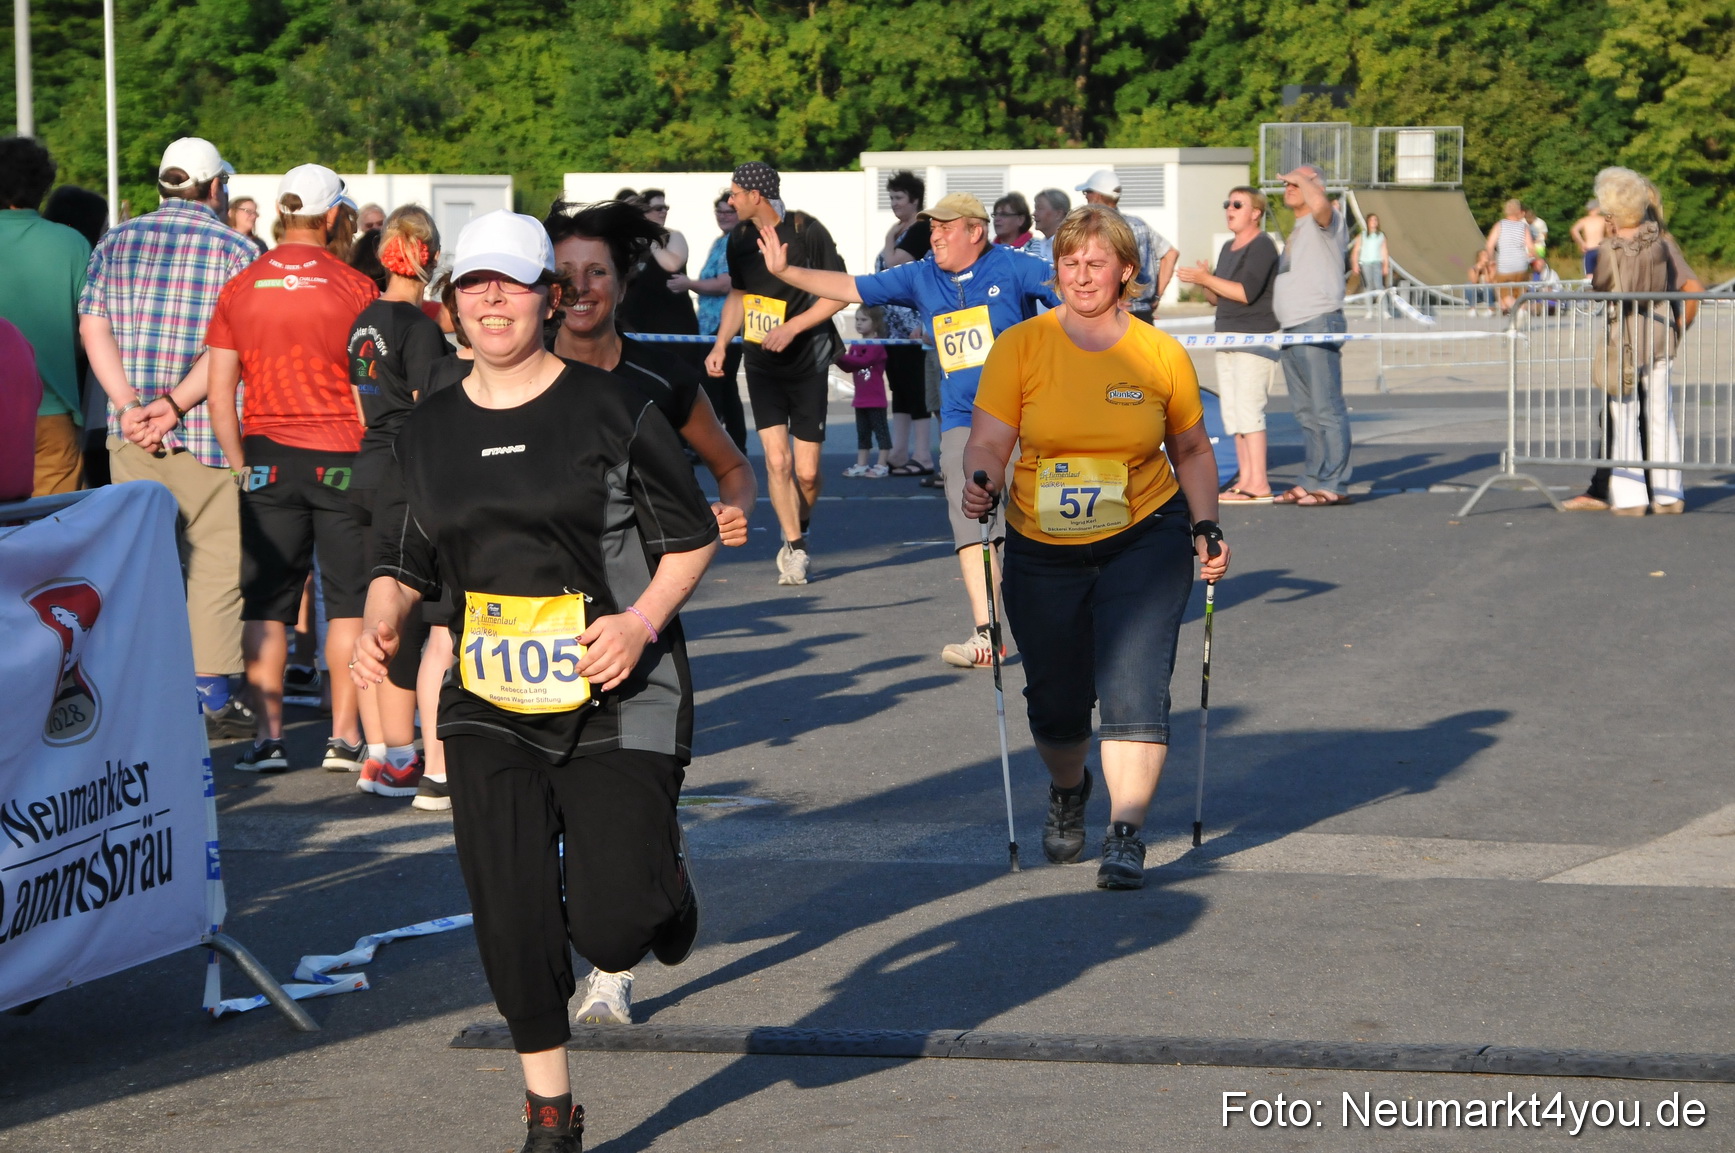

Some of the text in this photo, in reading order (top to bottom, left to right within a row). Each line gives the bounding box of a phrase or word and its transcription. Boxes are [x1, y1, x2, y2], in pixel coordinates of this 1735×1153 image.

[944, 328, 983, 356] 670
[1059, 487, 1101, 519] 57
[481, 614, 517, 626] firmenlauf
[465, 636, 580, 684] 1105
[489, 693, 562, 704] Regens Wagner Stiftung
[500, 685, 548, 695] Rebecca Lang
[49, 703, 86, 734] 1628
[0, 758, 149, 848] Neumarkter
